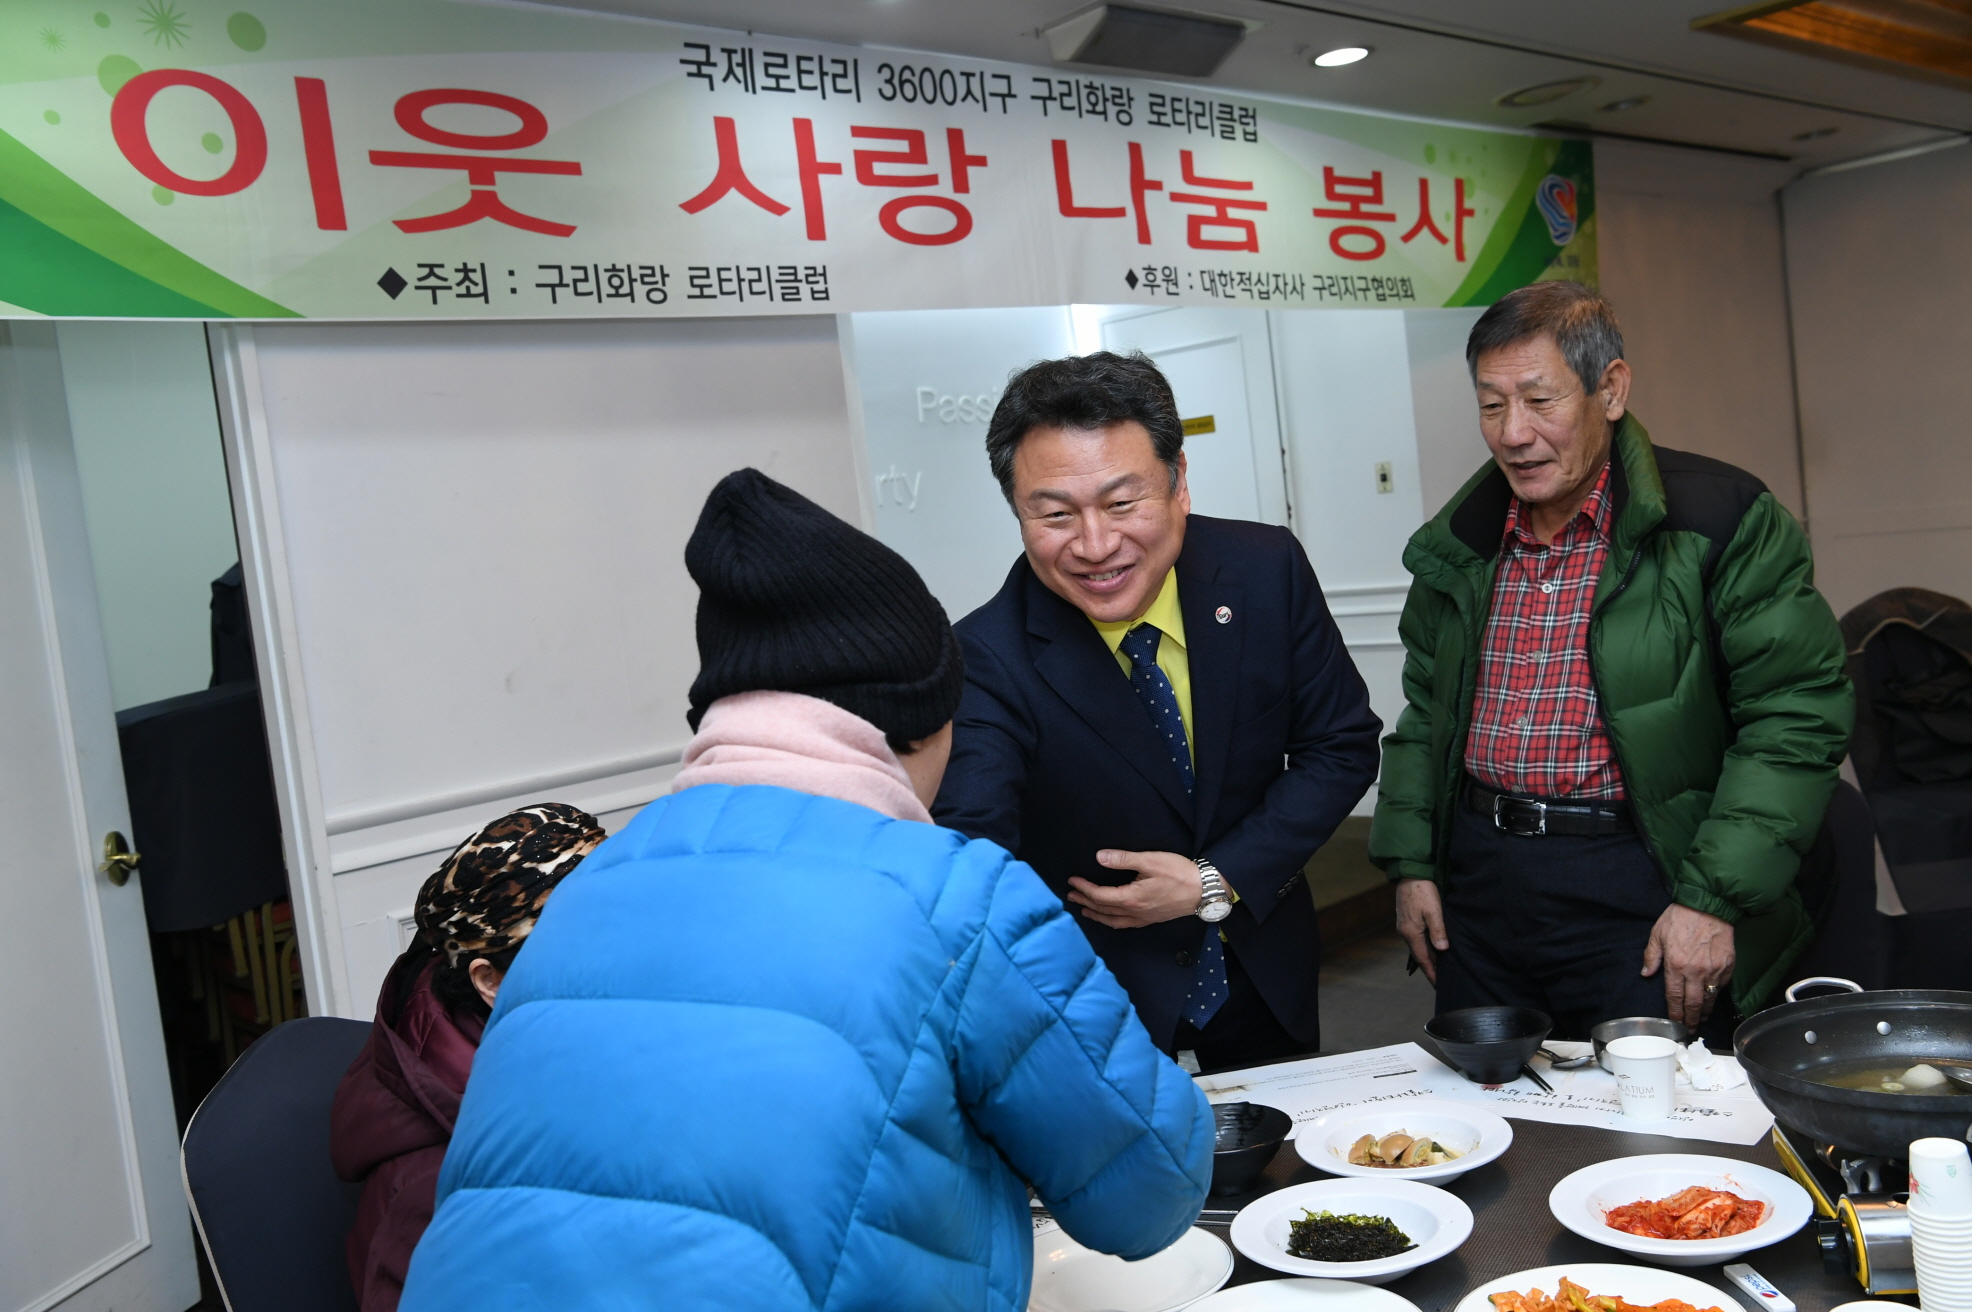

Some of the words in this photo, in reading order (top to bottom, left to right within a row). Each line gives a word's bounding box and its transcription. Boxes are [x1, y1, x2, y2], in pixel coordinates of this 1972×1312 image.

[679, 42, 862, 103] 국제로타리
[877, 63, 1018, 115] 3600지구
[1030, 77, 1135, 127] 구리화랑
[1147, 93, 1259, 144] 로타리클럽
[110, 68, 582, 238] 이웃
[679, 116, 988, 246] 사랑
[1051, 139, 1268, 253] 나눔
[1313, 166, 1475, 263] 봉사
[414, 262, 490, 306] 주최
[534, 263, 671, 305] 구리화랑
[686, 264, 831, 303] 로타리클럽
[1142, 265, 1180, 297] 후원
[1199, 269, 1306, 300] 대한적십자사
[1312, 274, 1416, 302] 구리지구협의회
